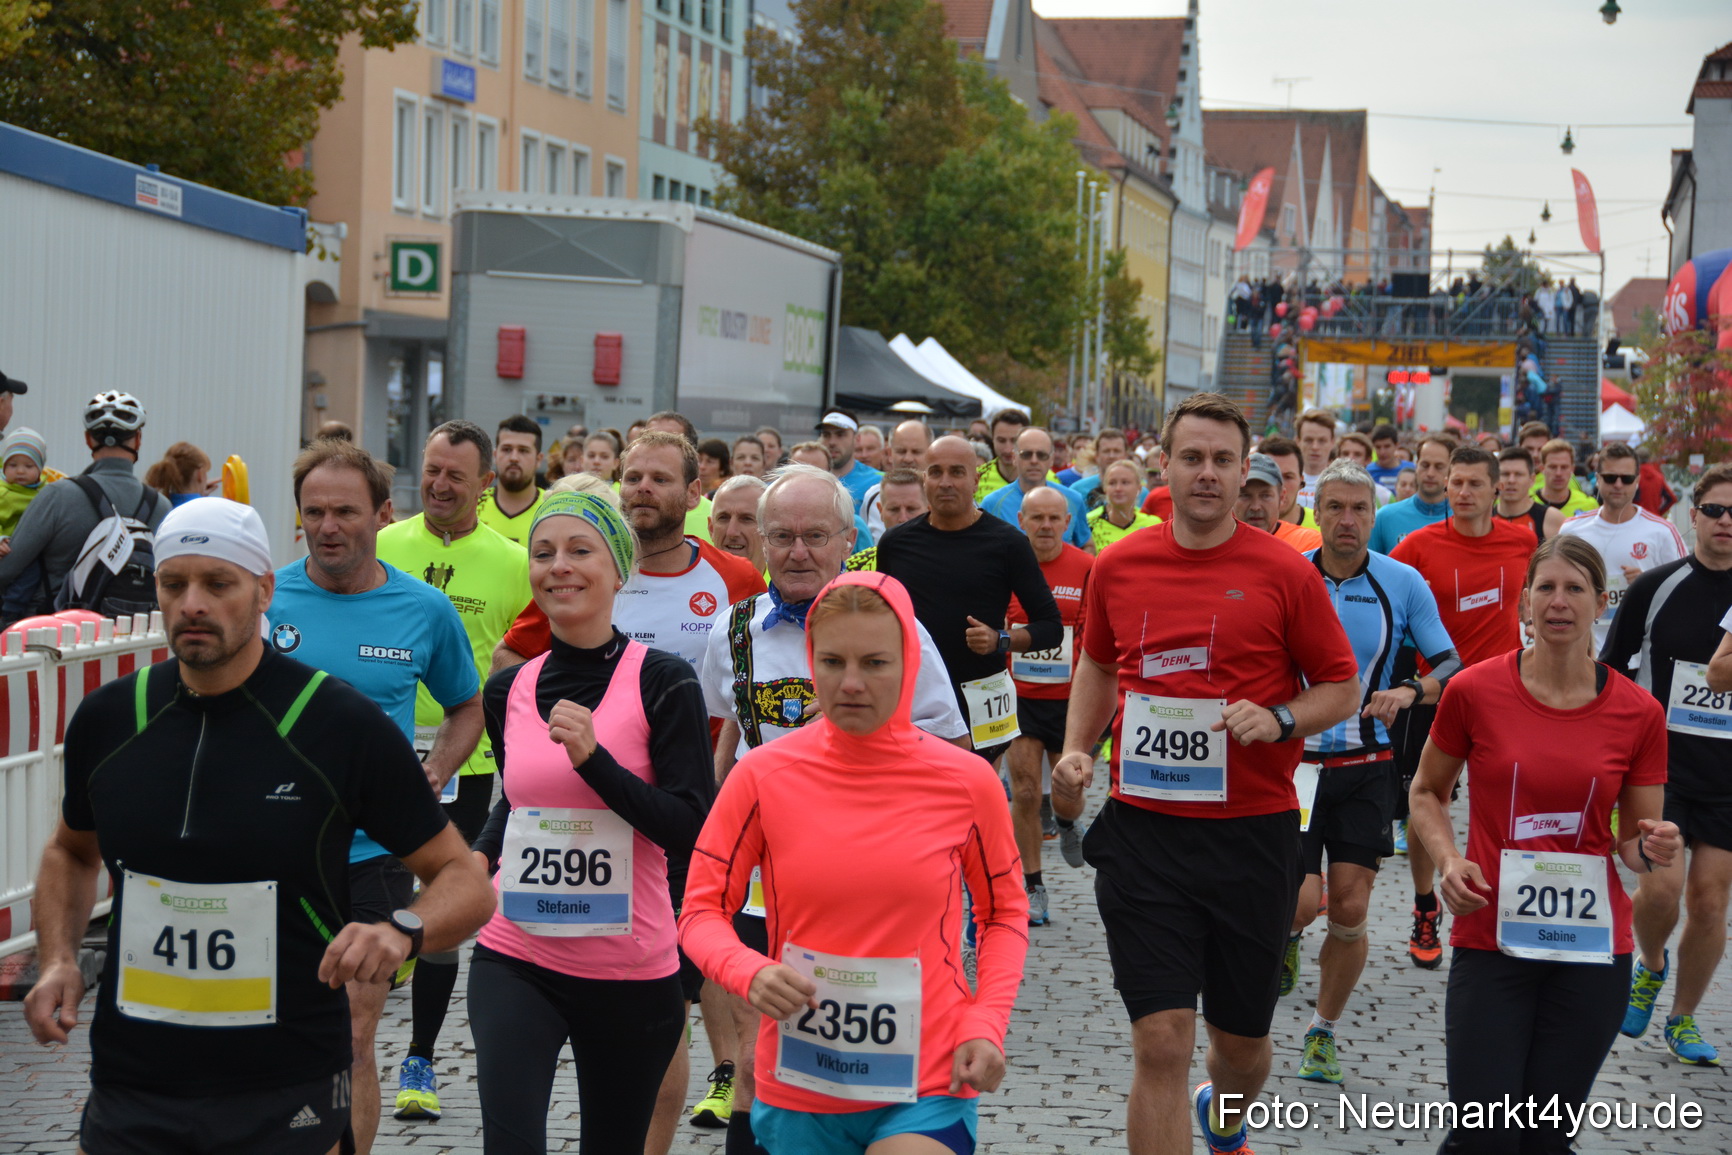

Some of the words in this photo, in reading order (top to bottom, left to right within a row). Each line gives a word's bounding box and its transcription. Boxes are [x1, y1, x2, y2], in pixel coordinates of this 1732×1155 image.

[398, 249, 434, 286] D
[783, 303, 824, 376] BOCK
[1051, 585, 1081, 597] JURA
[1471, 595, 1489, 605] DEHN
[274, 625, 299, 636] BMW
[681, 622, 714, 632] KOPP
[359, 645, 413, 662] BOCK
[1160, 654, 1191, 668] DEHN
[1029, 665, 1052, 673] Herbert
[983, 693, 1010, 718] 170
[1157, 705, 1194, 717] BOCK
[1688, 713, 1727, 726] Sebastian
[1134, 725, 1210, 762] 2498
[1150, 769, 1190, 783] Markus
[551, 820, 594, 831] BOCK
[1532, 819, 1561, 830] DEHN
[519, 846, 612, 887] 2596
[1546, 862, 1583, 873] BOCK
[173, 896, 228, 910] BOCK
[537, 899, 591, 914] Stefanie
[1516, 884, 1598, 920] 2012
[1538, 929, 1577, 943] Sabine
[153, 925, 236, 971] 416
[827, 968, 877, 984] BOCK
[797, 998, 897, 1046] 2356
[816, 1052, 869, 1075] Viktoria
[289, 1117, 321, 1129] adidas
